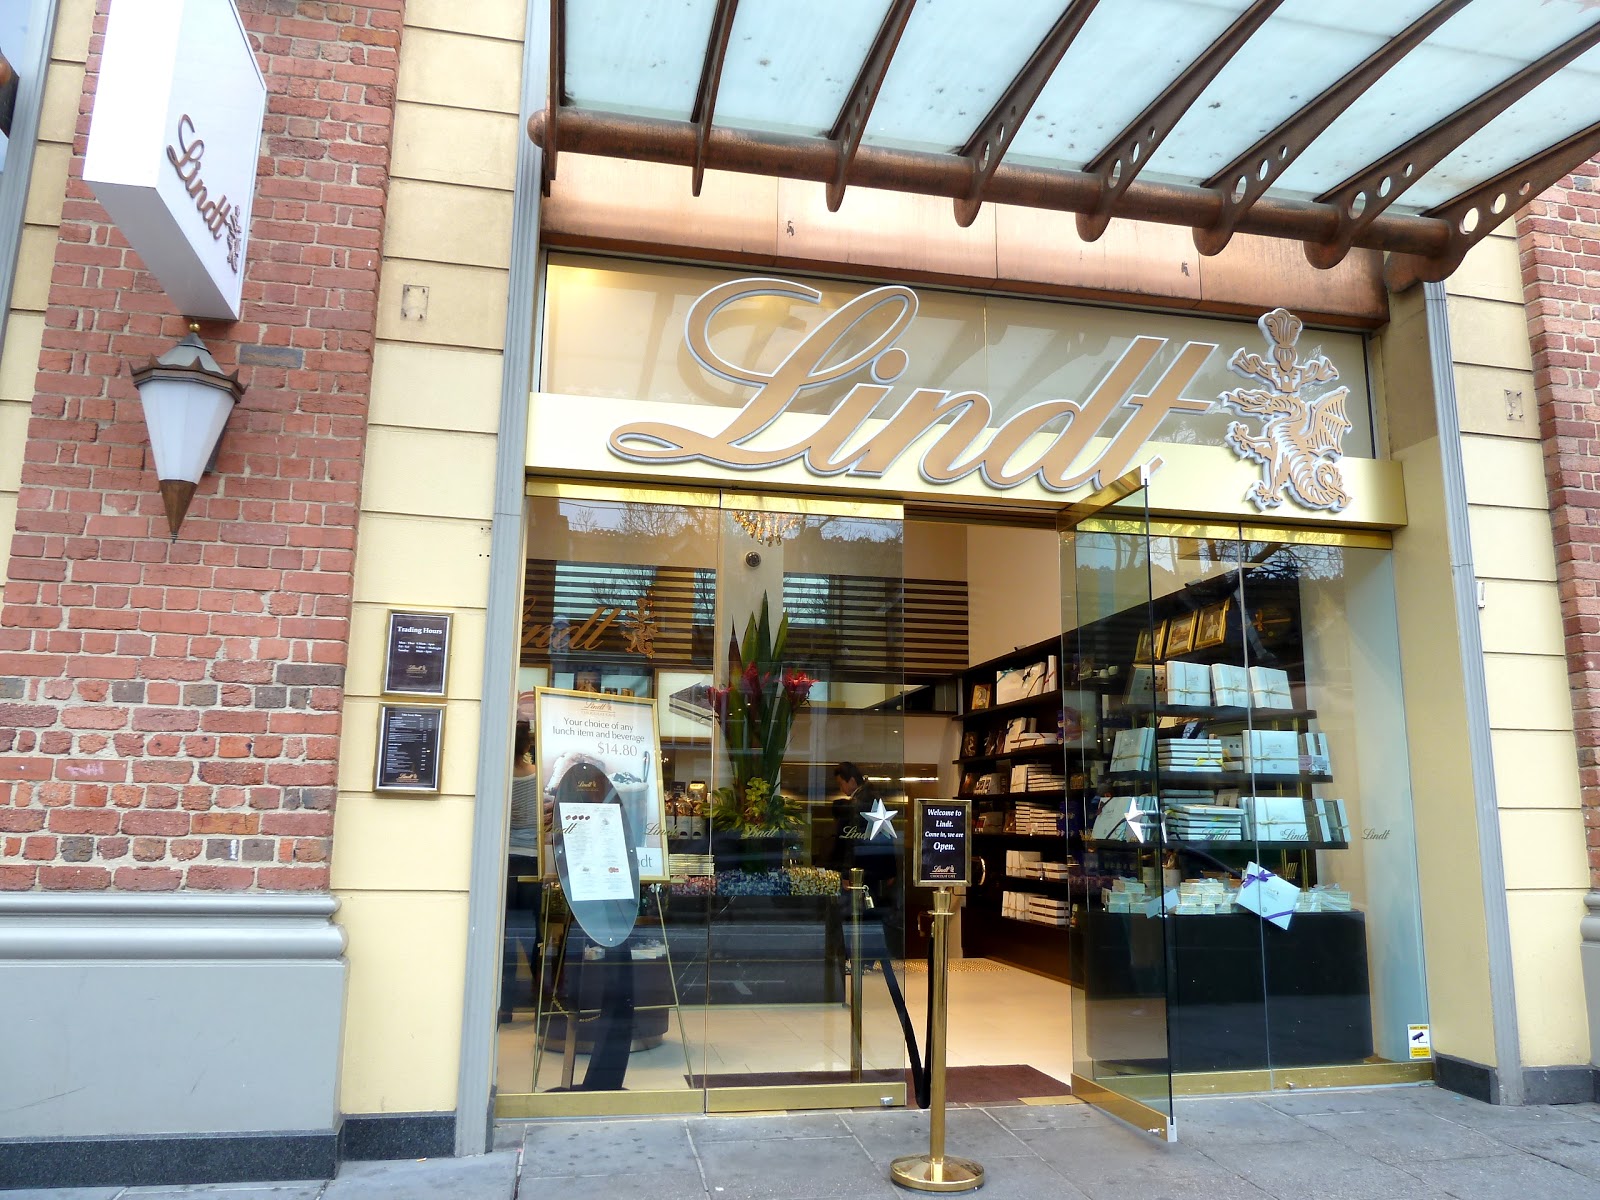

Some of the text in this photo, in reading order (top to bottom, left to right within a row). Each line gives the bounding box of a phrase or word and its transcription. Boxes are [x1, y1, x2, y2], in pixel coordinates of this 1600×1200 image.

[167, 114, 232, 240] Lindt
[606, 277, 1219, 493] Lindt
[397, 626, 422, 634] Trading
[521, 598, 621, 650] ndt
[564, 717, 583, 726] Your
[584, 719, 610, 729] choice
[620, 725, 634, 733] any
[552, 726, 645, 743] lunch item and beverage
[597, 742, 638, 757] $14.80
[927, 808, 954, 816] Welcome
[1361, 828, 1390, 840] Lindt
[933, 842, 955, 852] Open.
